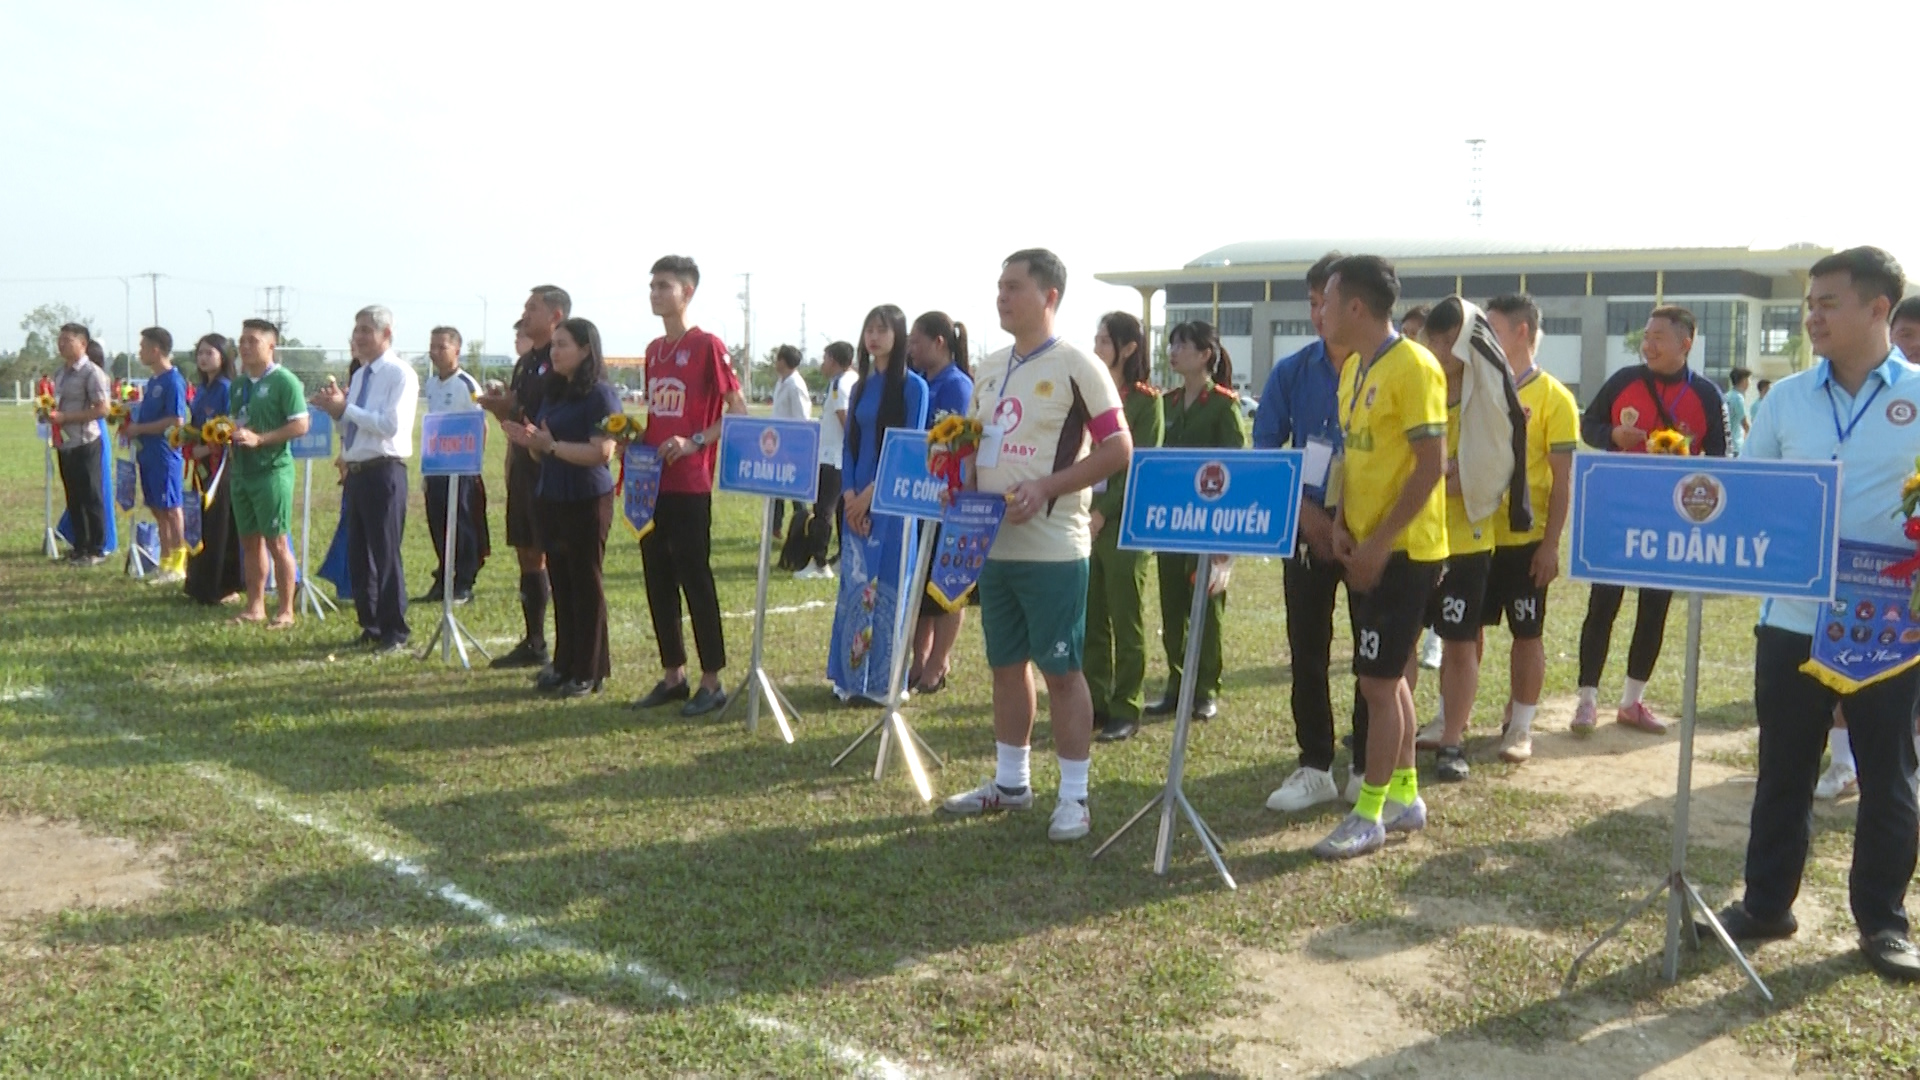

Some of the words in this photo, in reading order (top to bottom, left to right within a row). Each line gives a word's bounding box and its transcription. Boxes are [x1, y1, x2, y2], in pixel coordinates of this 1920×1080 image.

[1003, 442, 1036, 457] BABY
[739, 460, 752, 479] FC
[753, 458, 775, 481] DÂN
[893, 477, 910, 498] FC
[1146, 504, 1167, 530] FC
[1171, 502, 1208, 532] DÂN
[1625, 528, 1658, 559] FC
[1667, 526, 1726, 565] DÂN
[1735, 530, 1771, 568] LÝ
[1442, 596, 1466, 624] 29
[1514, 597, 1536, 622] 94
